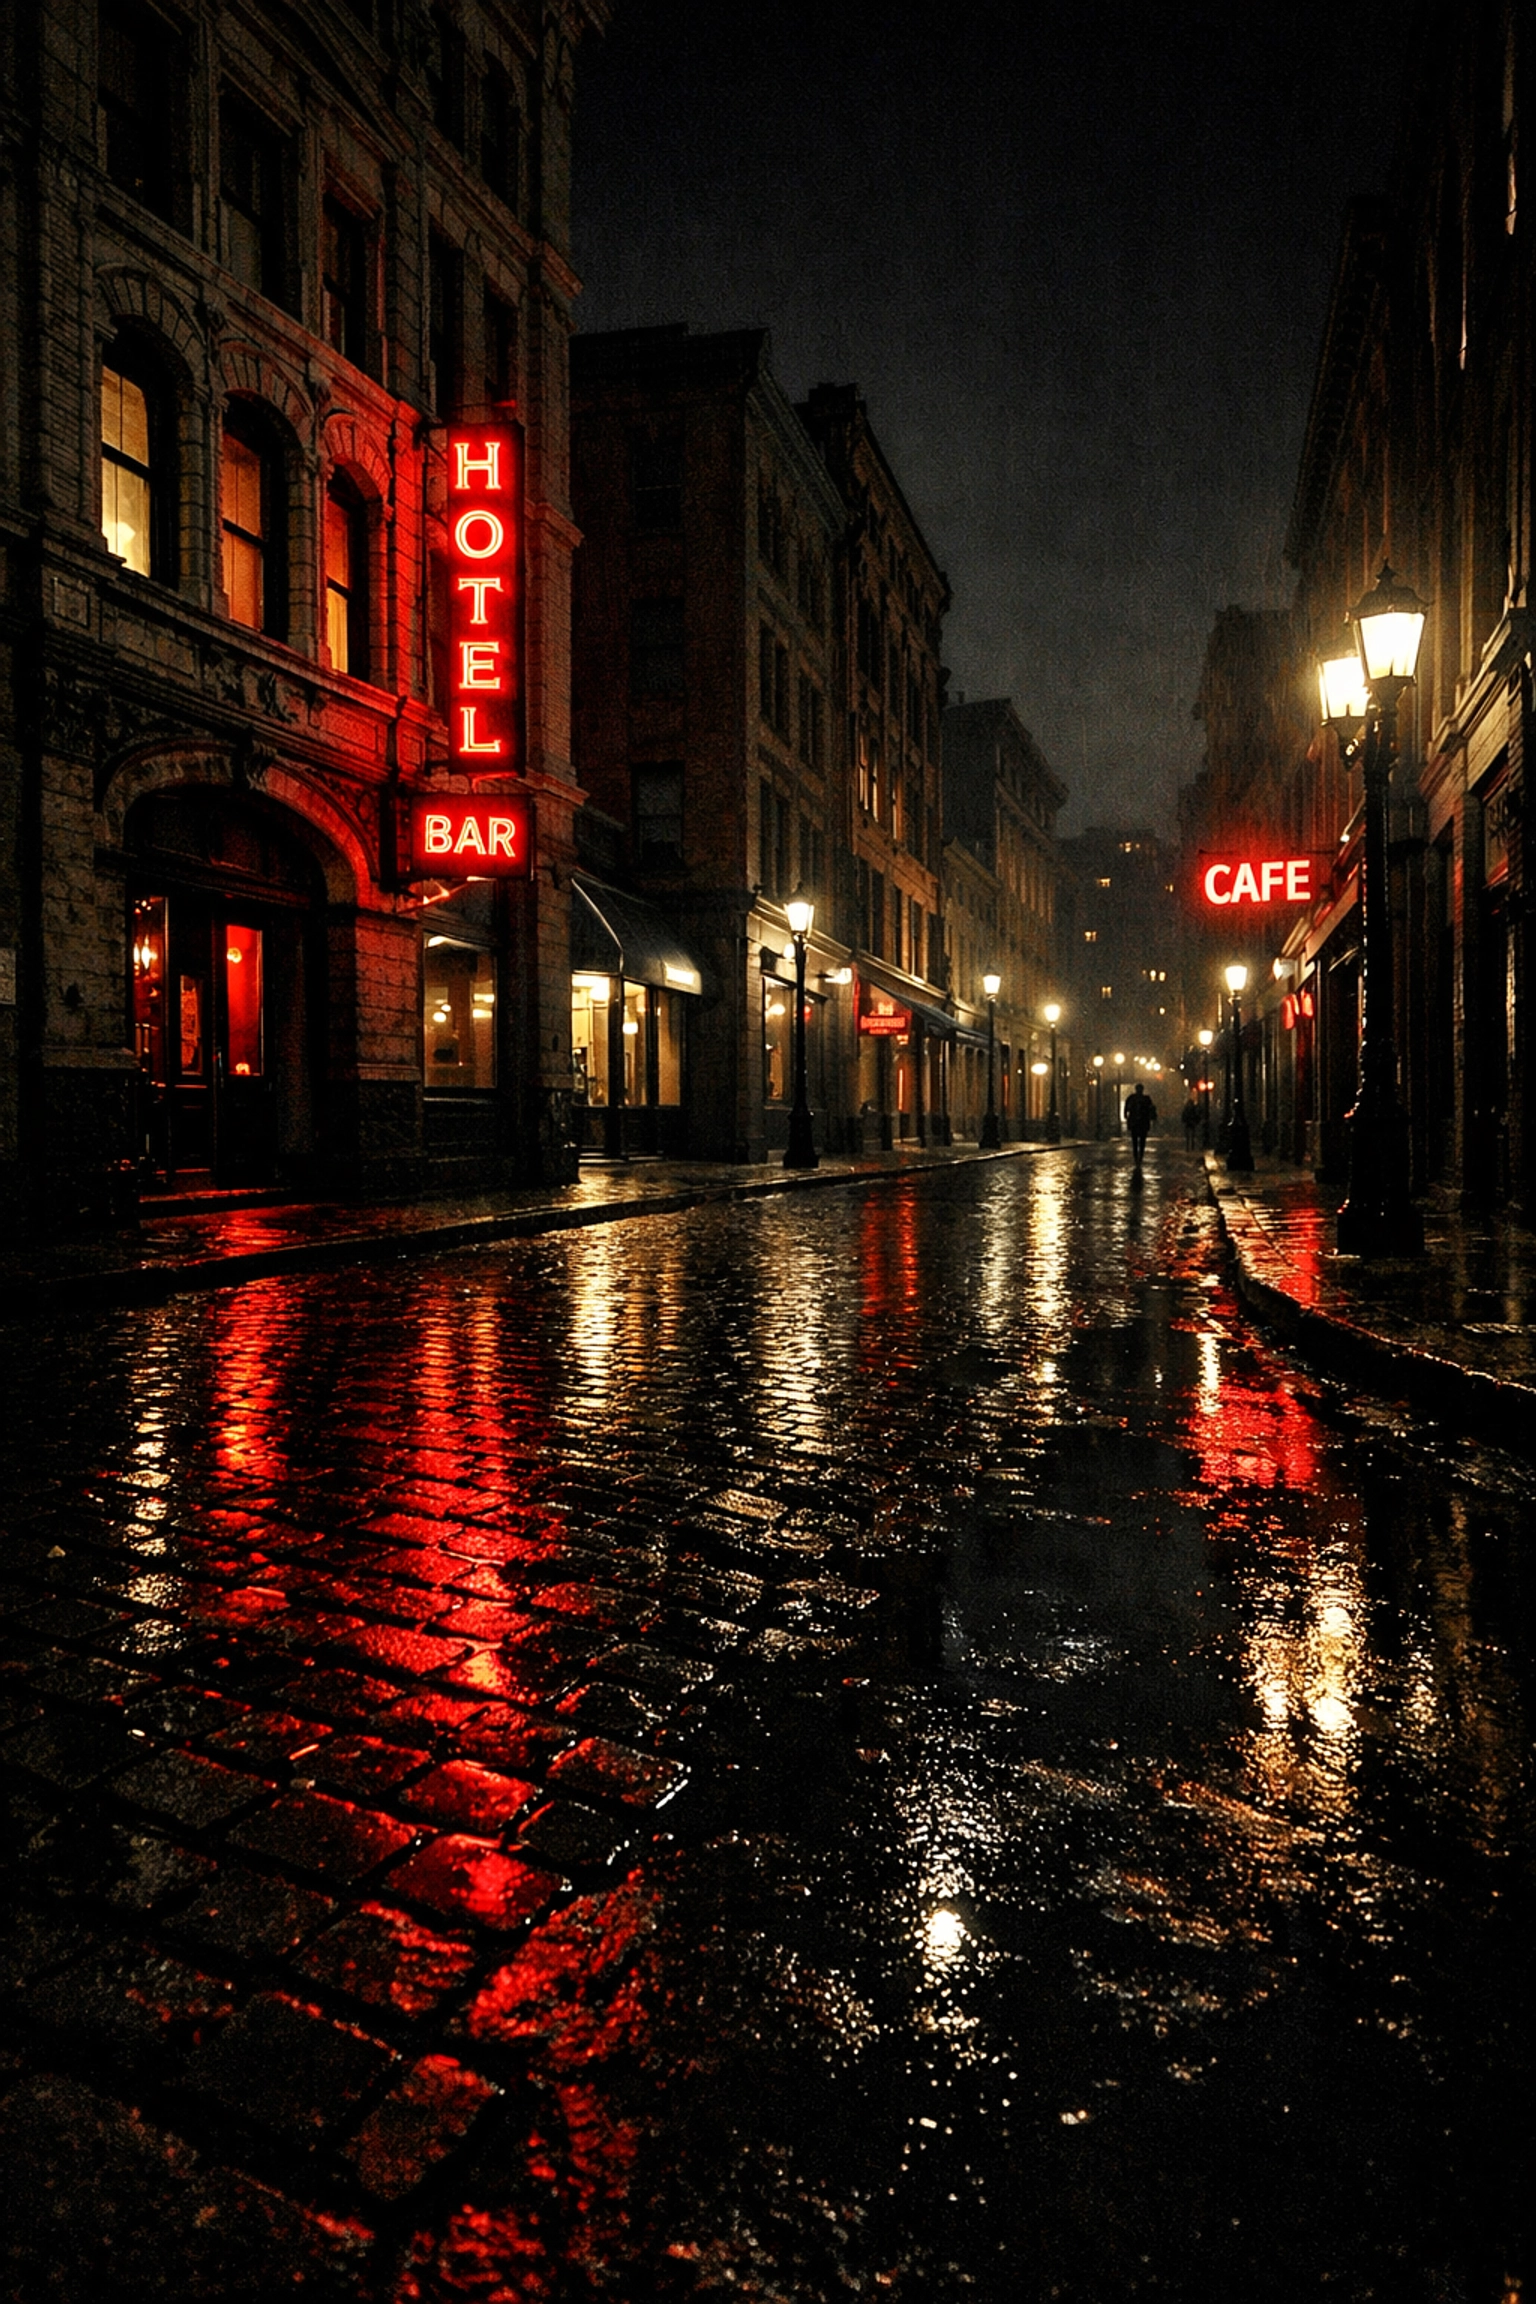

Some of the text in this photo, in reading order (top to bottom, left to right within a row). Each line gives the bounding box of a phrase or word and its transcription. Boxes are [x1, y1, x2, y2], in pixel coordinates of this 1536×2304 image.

[454, 441, 504, 753] HOTEL
[424, 814, 516, 858] BAR
[1204, 859, 1311, 905] CAFE
